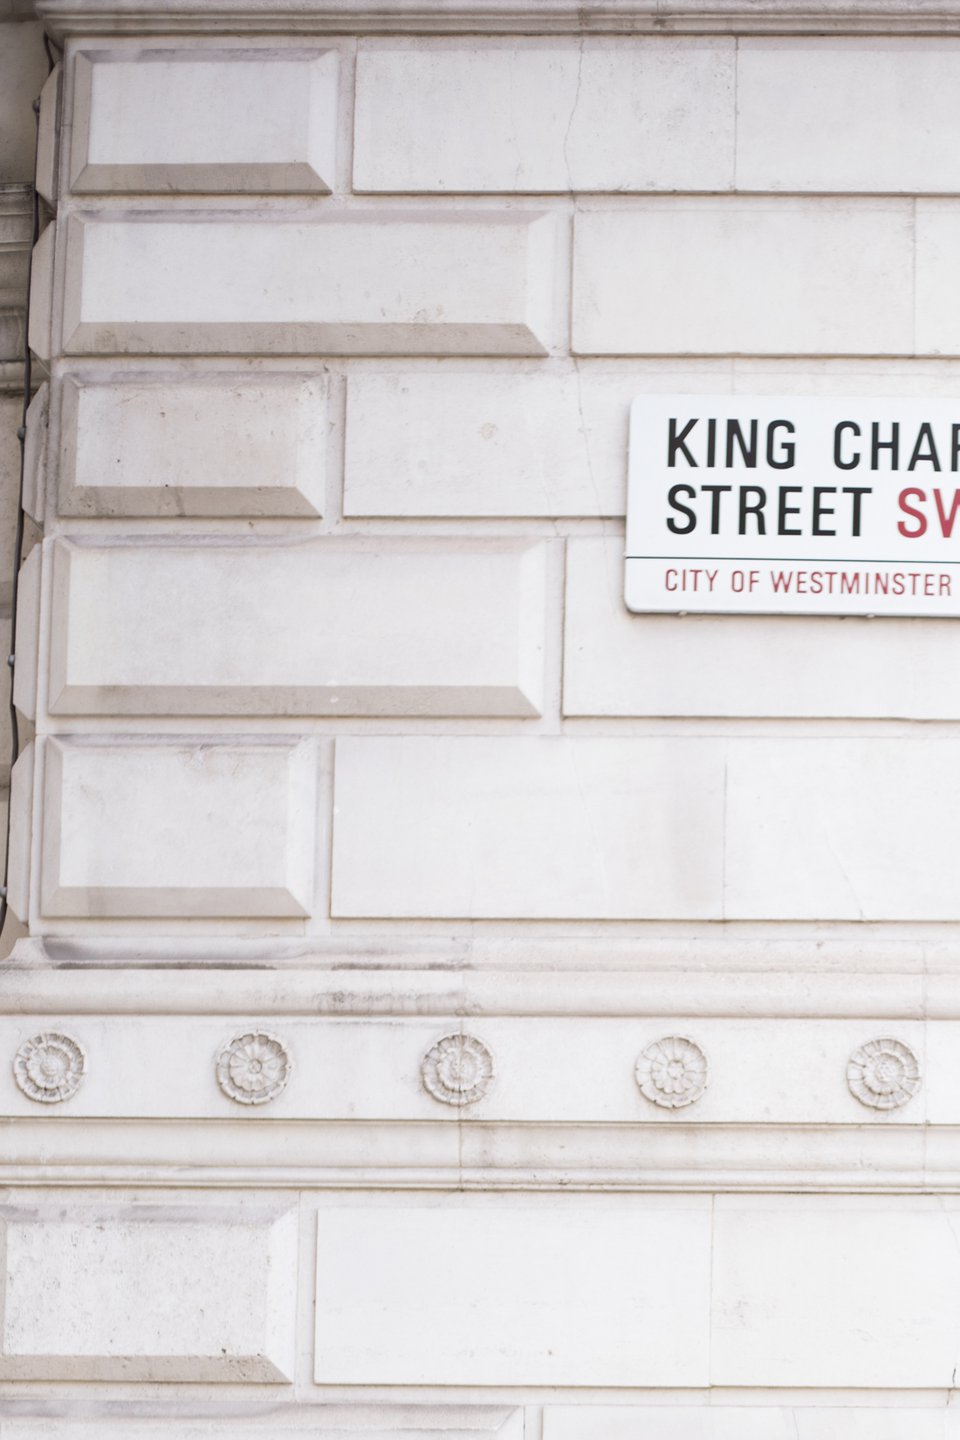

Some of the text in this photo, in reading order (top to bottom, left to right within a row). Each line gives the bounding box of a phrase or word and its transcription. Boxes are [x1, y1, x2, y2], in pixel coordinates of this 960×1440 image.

[667, 418, 796, 470] KING
[666, 484, 872, 536] STREET
[665, 568, 952, 596] CITY OF WESTMINSTER
